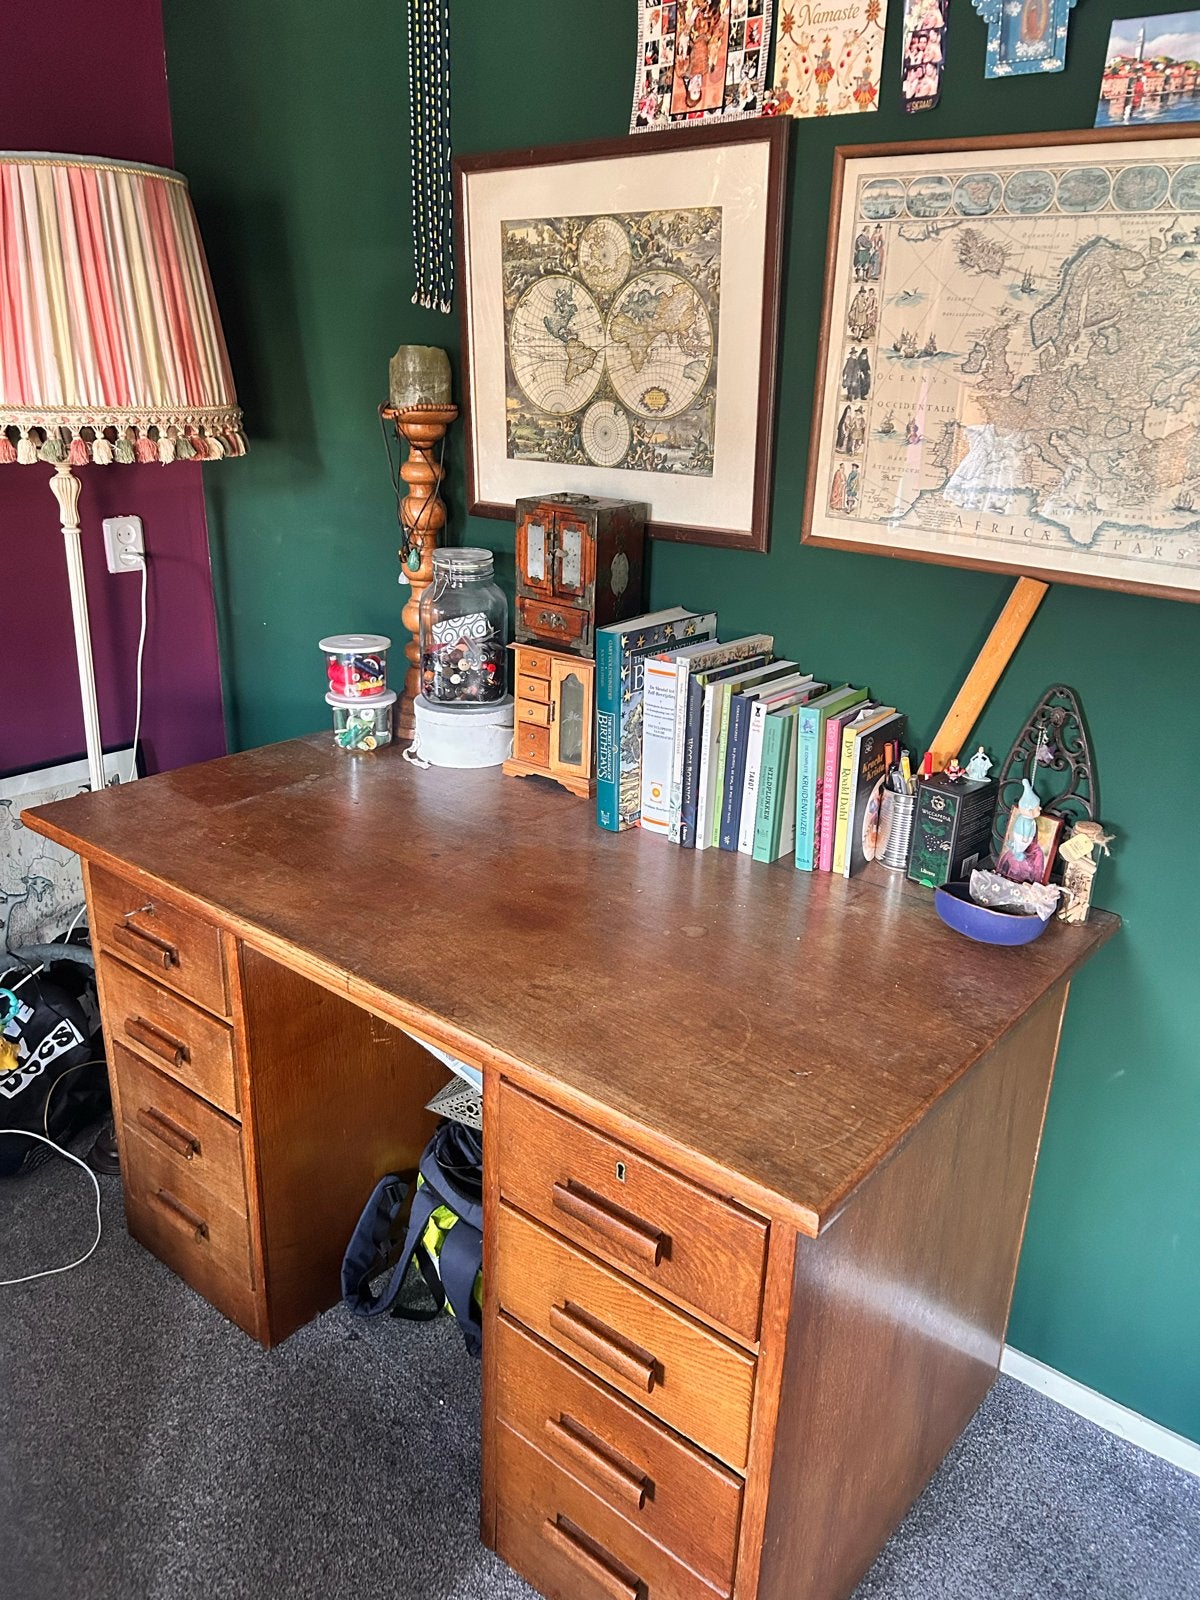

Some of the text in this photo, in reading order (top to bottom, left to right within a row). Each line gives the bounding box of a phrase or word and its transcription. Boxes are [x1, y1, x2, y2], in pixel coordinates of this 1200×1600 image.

[797, 3, 860, 28] Namaste
[877, 401, 956, 413] OCCIDENTALIS
[1113, 539, 1187, 560] PARS
[597, 714, 608, 778] BIRTHDAYS
[683, 737, 694, 804] WICCA BOTANICA
[747, 770, 755, 790] TAROT
[824, 759, 833, 789] LOSSE
[839, 767, 851, 795] Roald
[762, 766, 774, 820] WILDPLUKKEN
[799, 774, 809, 836] KRUIDENWIJZER
[822, 791, 831, 838] KRABBELS
[838, 796, 849, 820] Dahl
